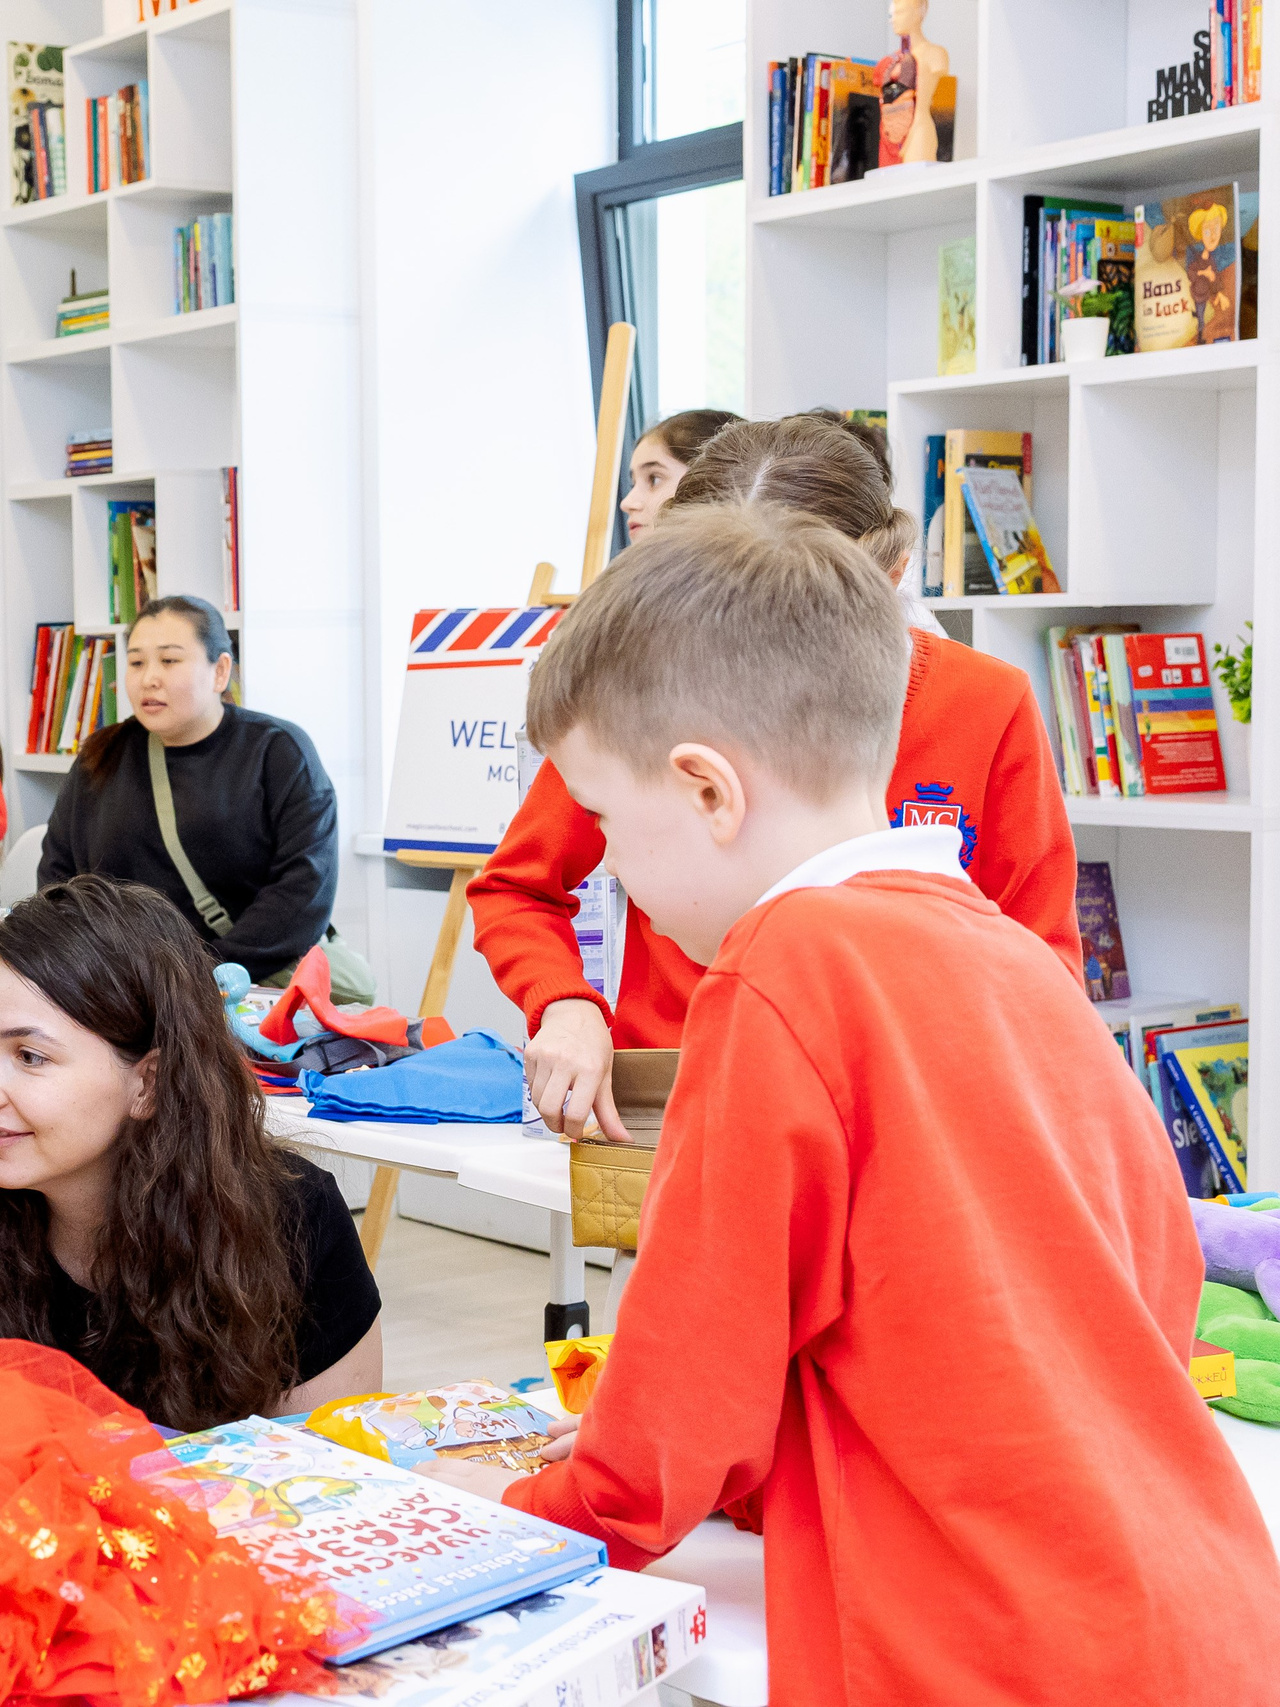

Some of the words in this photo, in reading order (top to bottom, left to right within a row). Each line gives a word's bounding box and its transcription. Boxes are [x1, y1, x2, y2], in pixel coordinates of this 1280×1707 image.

[1143, 279, 1182, 299] Hans
[1155, 298, 1189, 318] Luck
[451, 720, 526, 749] WEL
[487, 765, 520, 782] MC
[366, 1581, 441, 1610] Биссе
